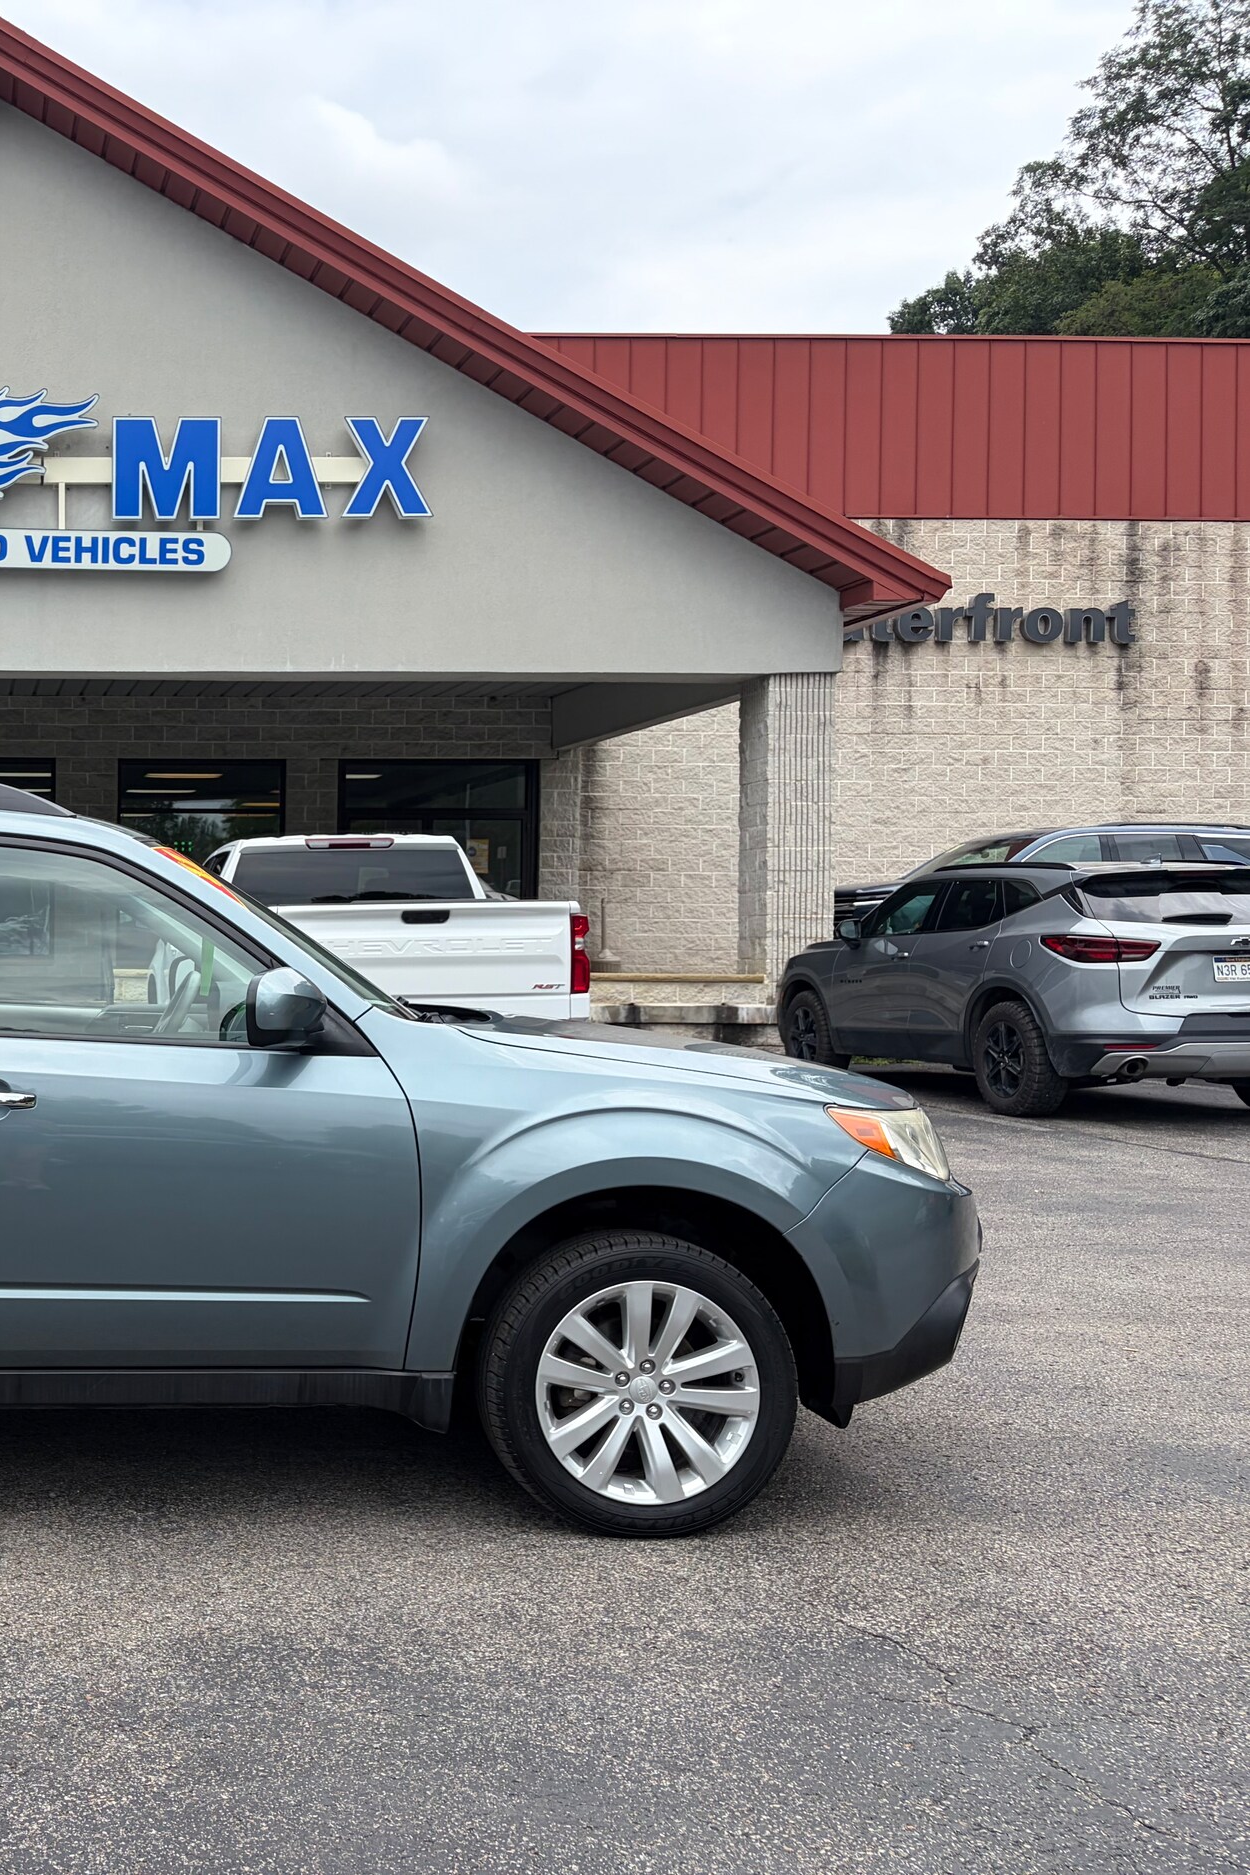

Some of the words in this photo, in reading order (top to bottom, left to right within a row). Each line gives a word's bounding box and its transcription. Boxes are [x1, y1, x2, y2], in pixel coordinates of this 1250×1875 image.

[111, 414, 432, 521] MAX
[29, 532, 206, 566] VEHICLES
[843, 592, 1137, 644] terfront
[321, 937, 553, 956] HEVROLET
[1216, 964, 1238, 976] N3R
